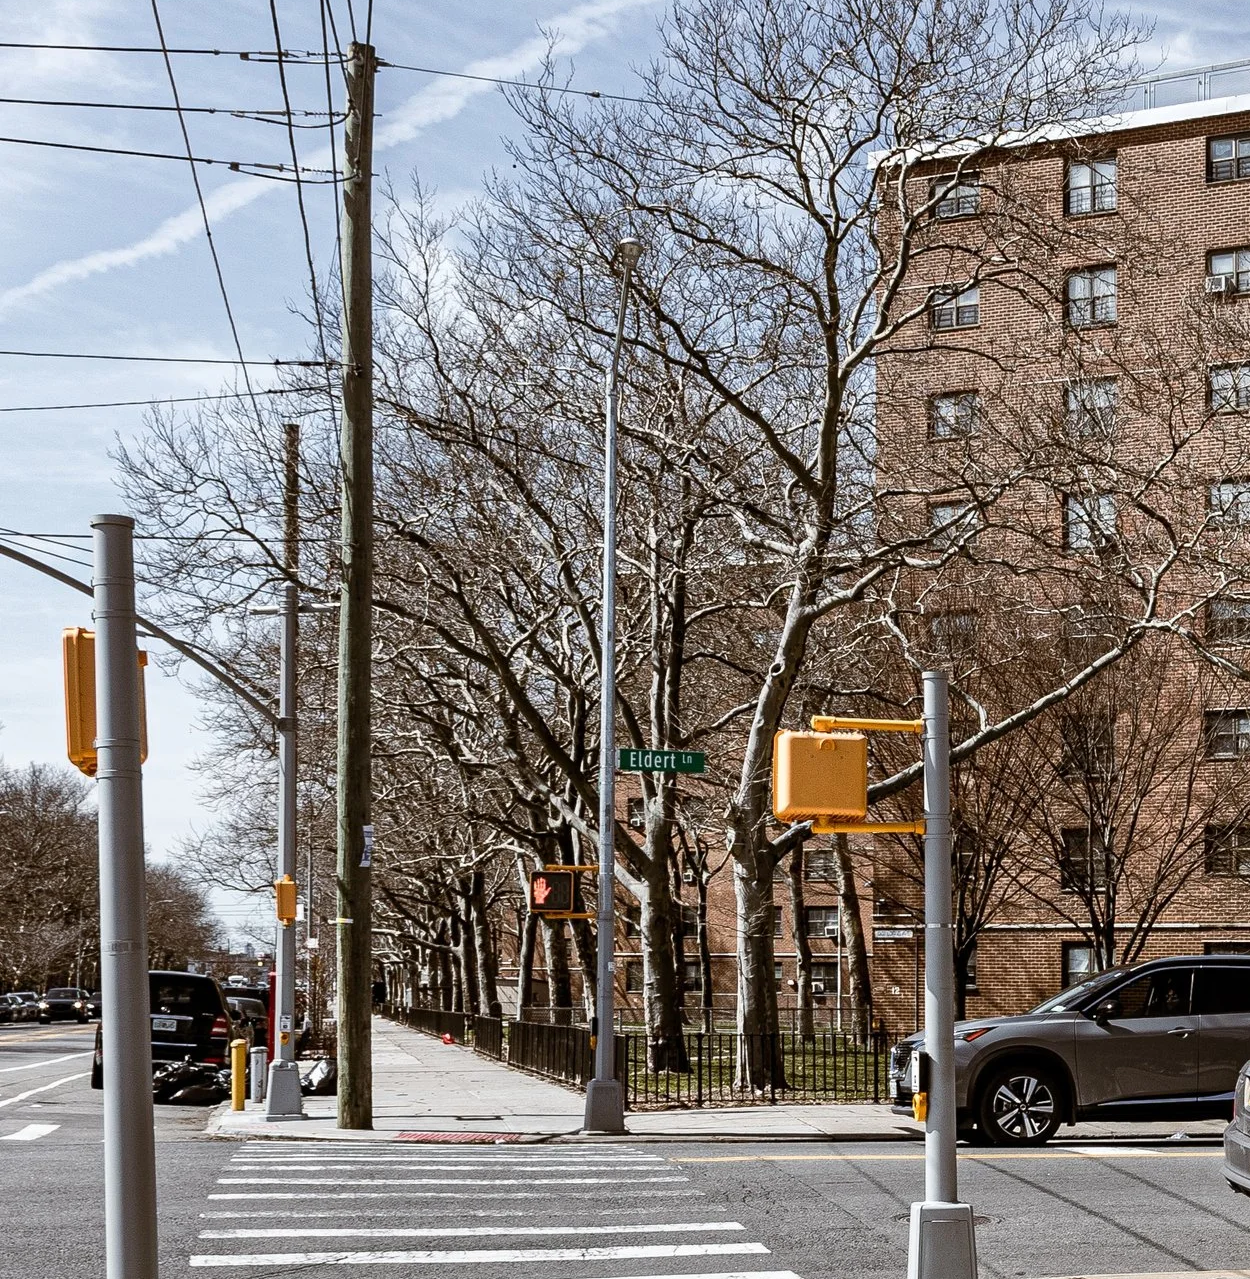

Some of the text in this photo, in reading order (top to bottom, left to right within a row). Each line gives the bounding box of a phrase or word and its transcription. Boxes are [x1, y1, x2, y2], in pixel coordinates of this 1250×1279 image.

[630, 751, 693, 769] Eldert Ln
[891, 986, 900, 995] 12
